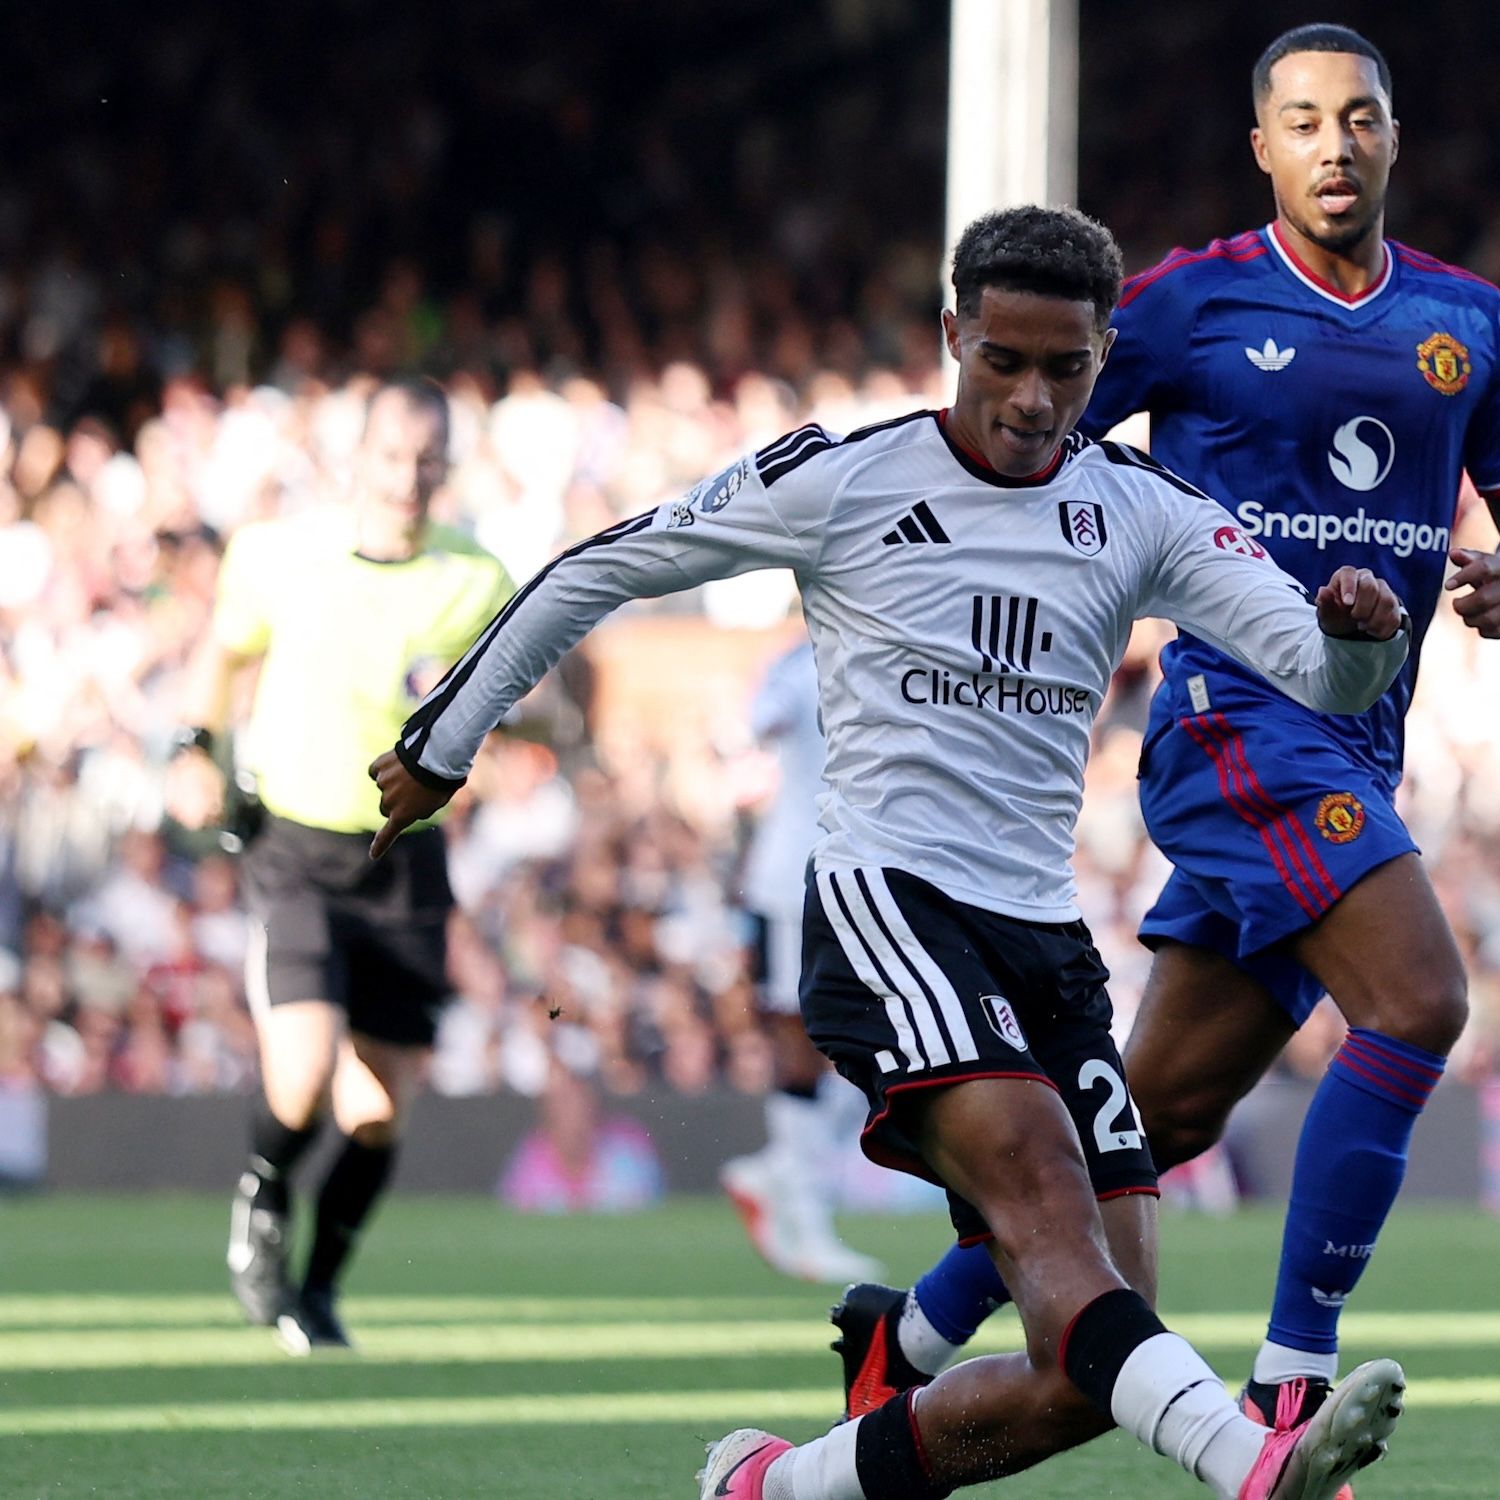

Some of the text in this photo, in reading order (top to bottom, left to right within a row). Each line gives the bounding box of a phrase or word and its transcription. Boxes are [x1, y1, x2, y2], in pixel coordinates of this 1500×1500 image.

[1237, 500, 1449, 557] Snapdragon
[901, 669, 1090, 714] ClickHouse
[1078, 1058, 1146, 1154] 2
